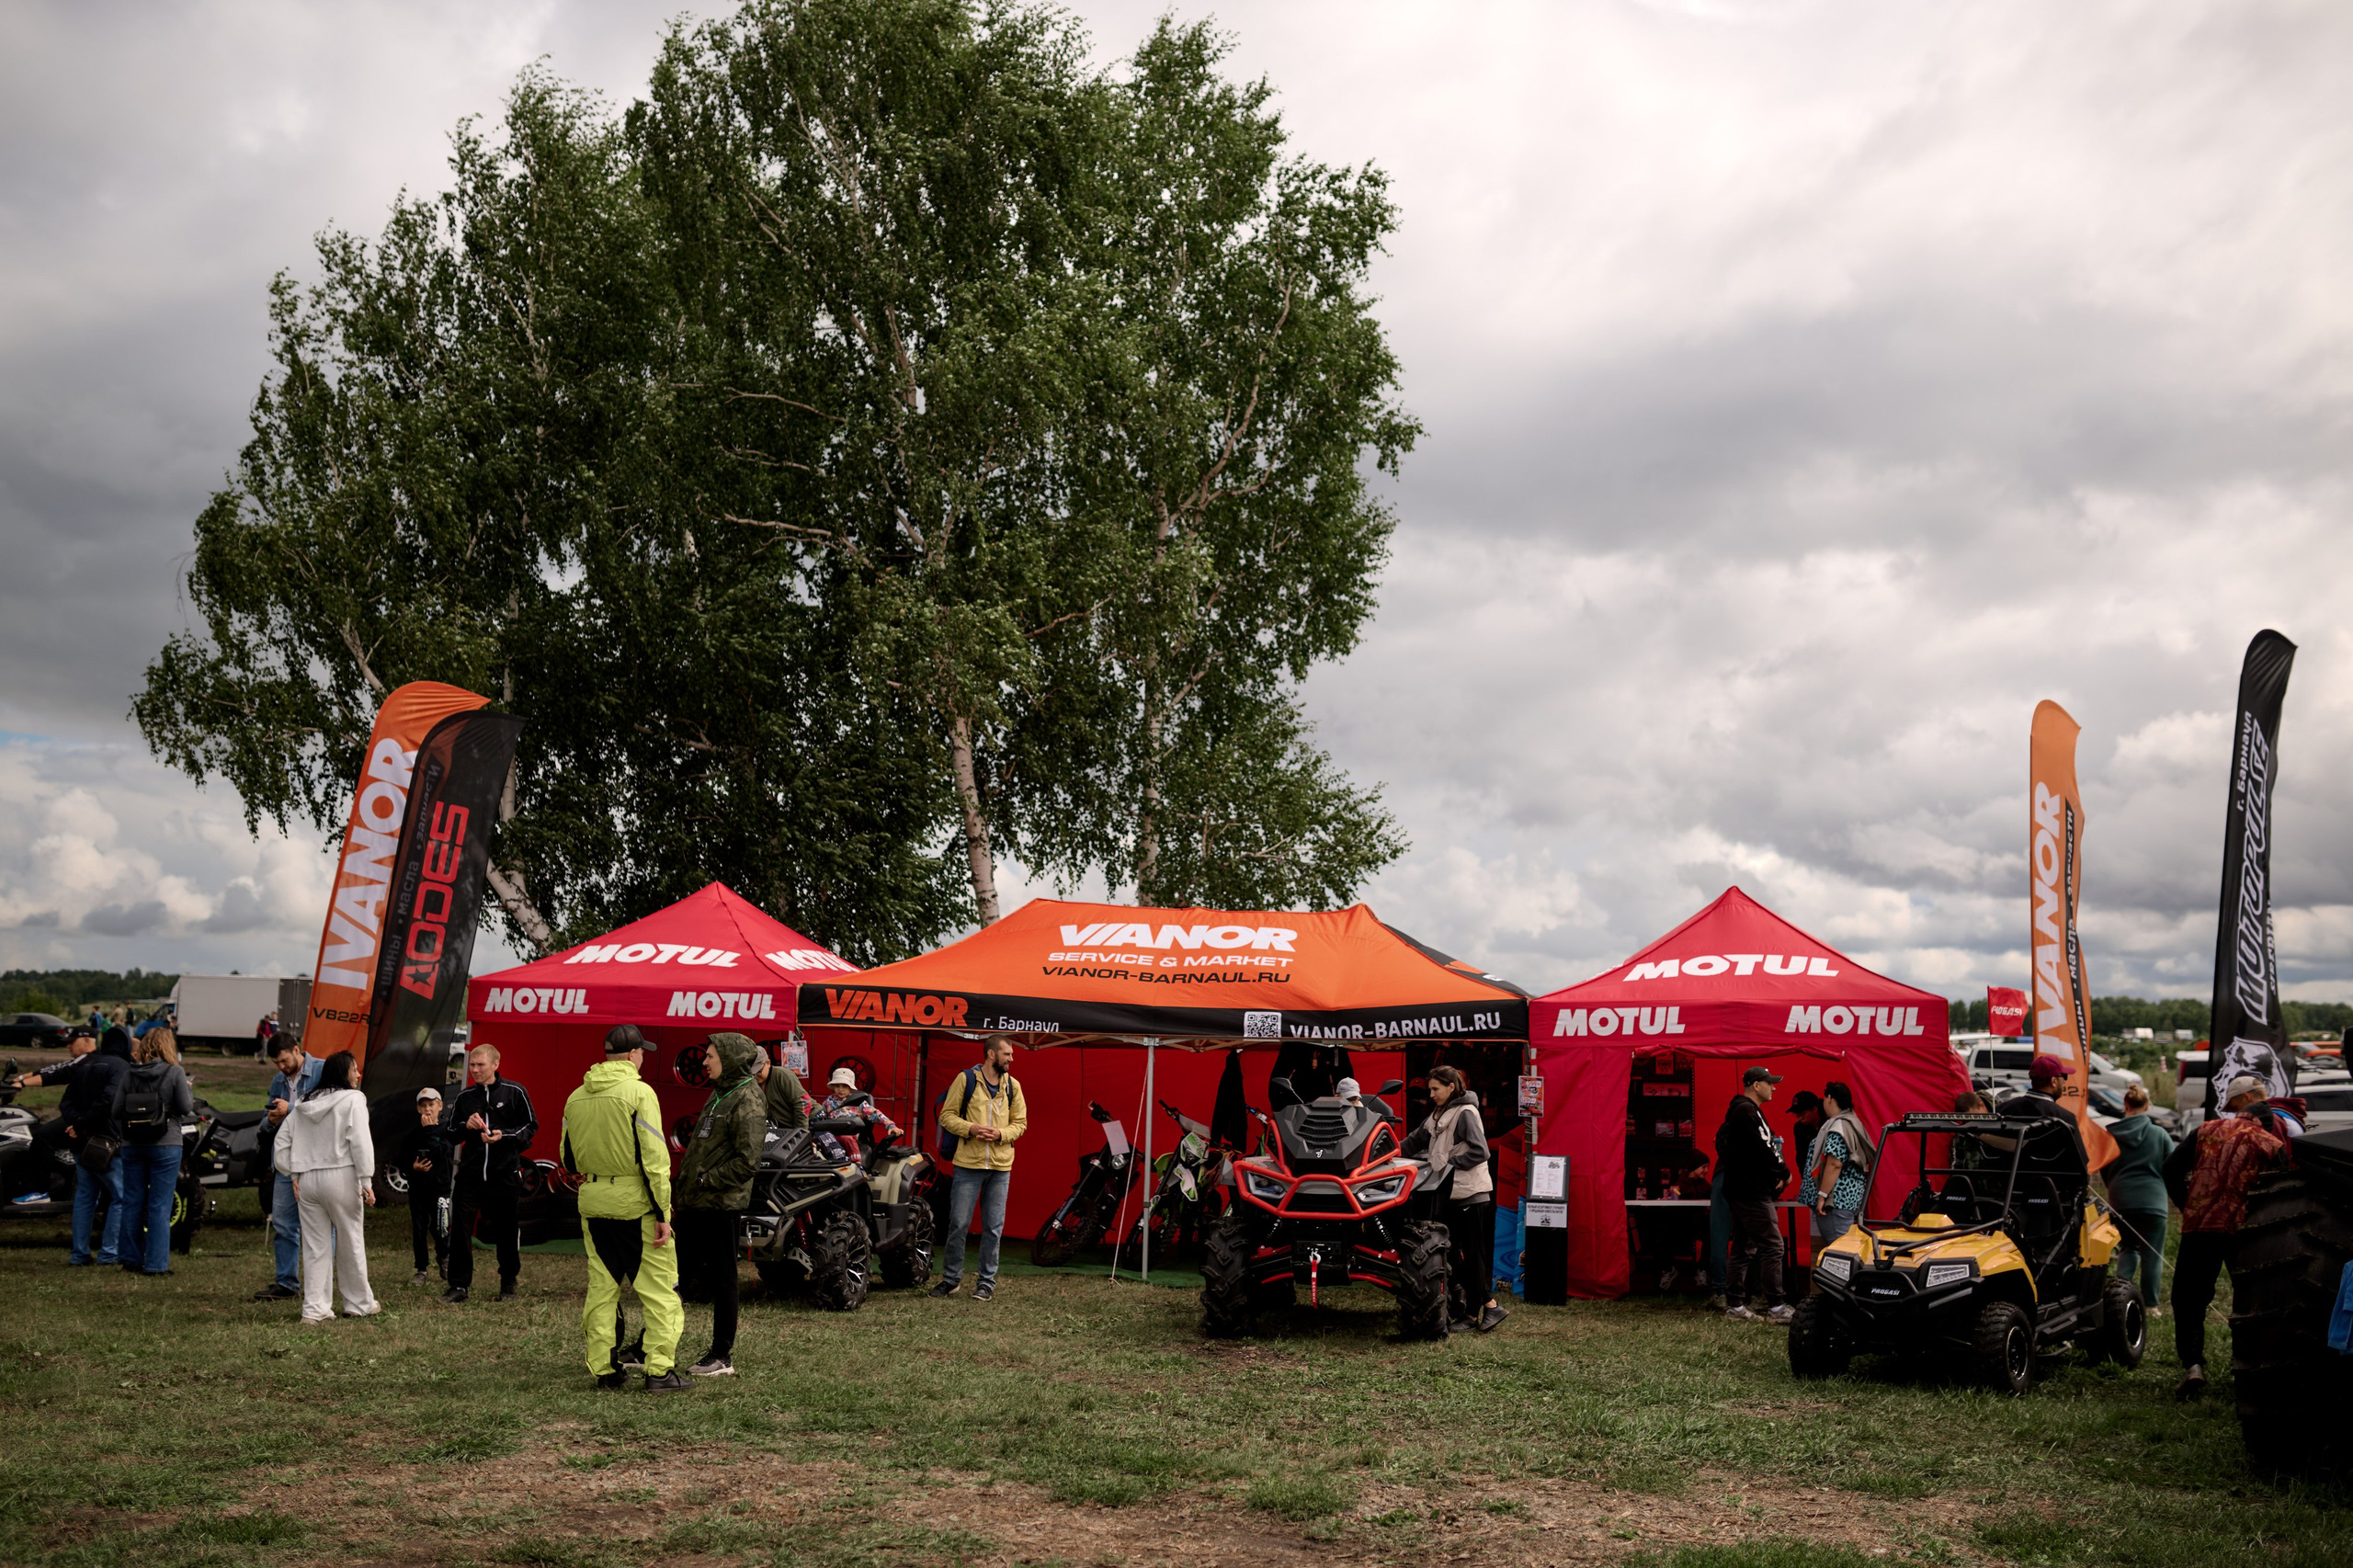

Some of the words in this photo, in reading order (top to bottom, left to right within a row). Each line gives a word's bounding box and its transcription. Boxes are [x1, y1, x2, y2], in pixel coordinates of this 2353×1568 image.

[2237, 710, 2252, 793] Барнаул
[2235, 718, 2269, 1025] MOTOPULSE
[399, 801, 470, 1000] AODES
[1059, 923, 1298, 952] VIANOR
[563, 943, 741, 968] MOTUL
[765, 949, 861, 972] MOTUL
[1048, 952, 1154, 966] SERVICE
[1159, 957, 1177, 967] &
[1183, 955, 1293, 968] MARKET
[1622, 953, 1839, 982] MOTUL
[1042, 966, 1290, 983] VIANOR-BARNAUL.RU
[484, 987, 589, 1014] MOTUL
[666, 991, 777, 1019] MOTUL
[824, 988, 969, 1027] VIANOR
[983, 1017, 994, 1029] г.
[998, 1016, 1060, 1032] Барнаул
[1290, 1012, 1501, 1039] VIANOR-BARNAUL.RU
[1552, 1006, 1686, 1037] MOTUL
[1784, 1006, 1924, 1037] MOTUL
[1870, 1288, 1900, 1296] PROGASI
